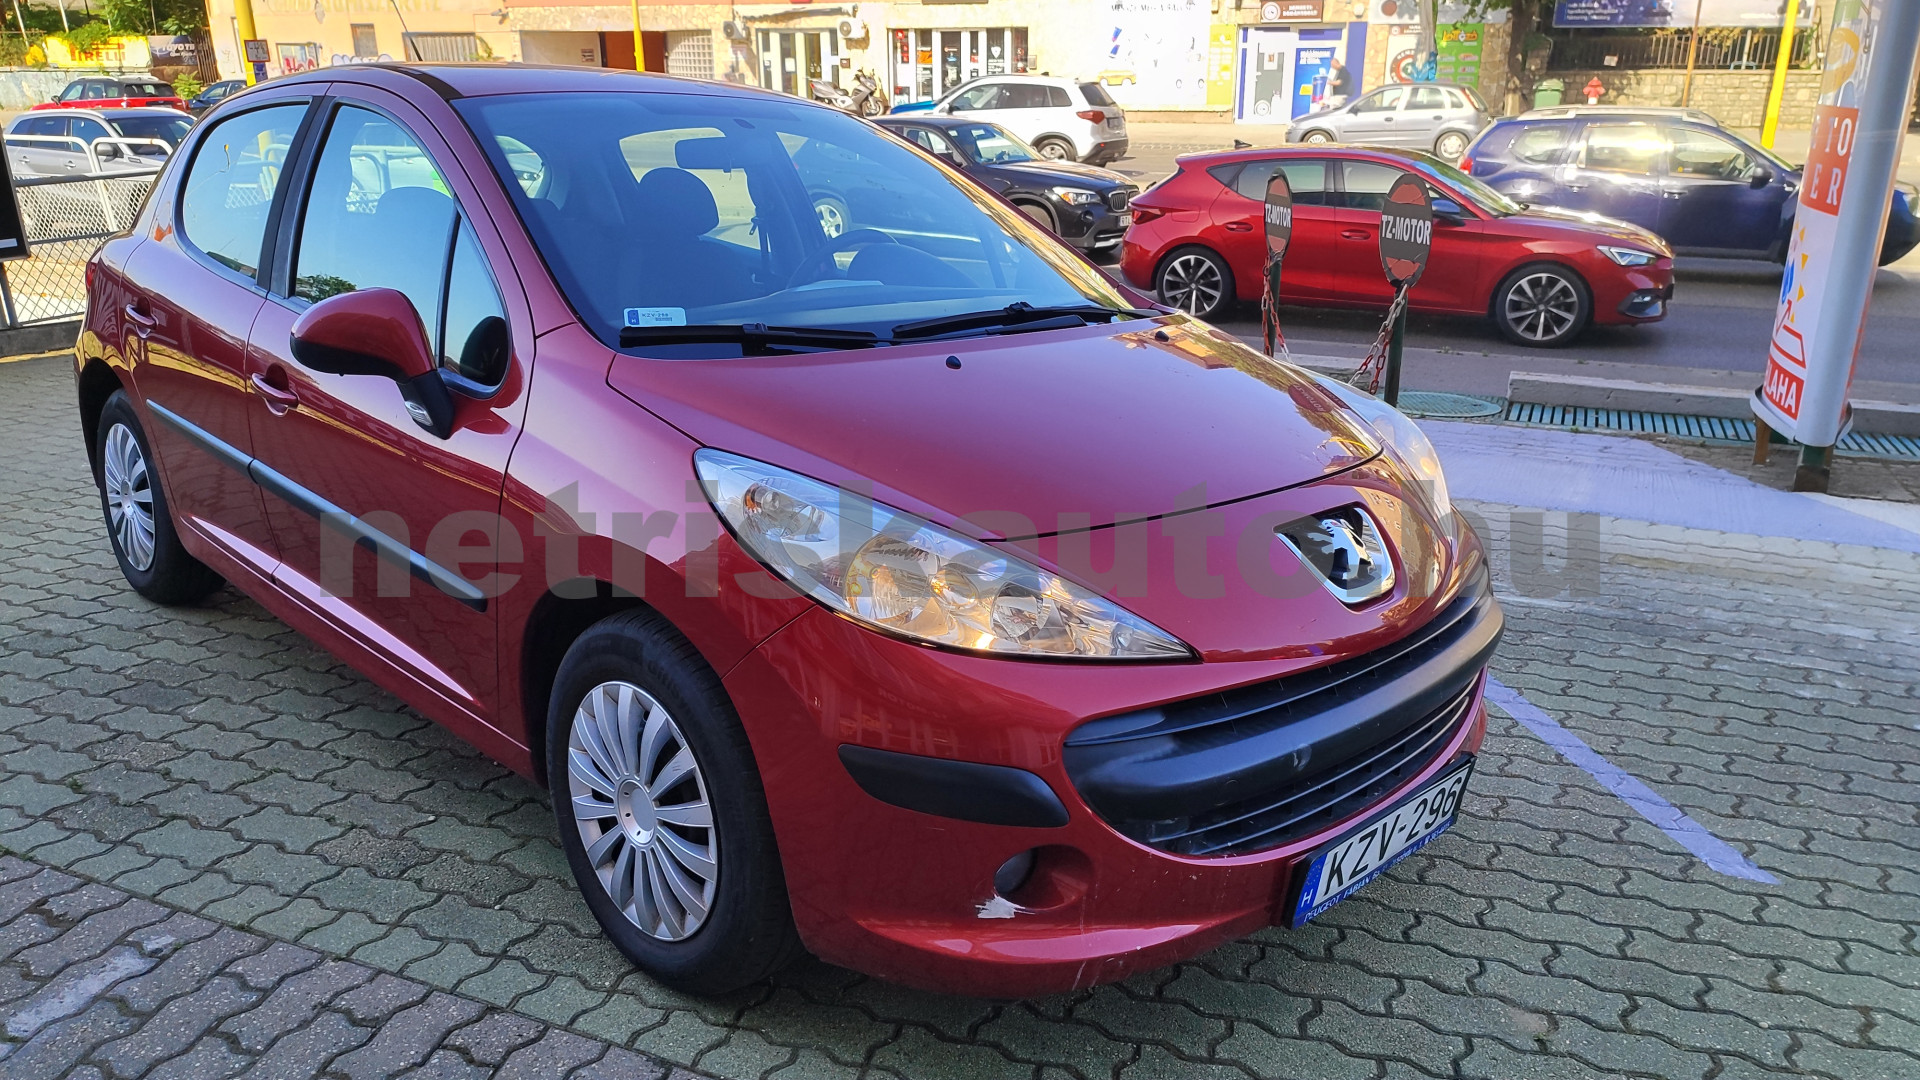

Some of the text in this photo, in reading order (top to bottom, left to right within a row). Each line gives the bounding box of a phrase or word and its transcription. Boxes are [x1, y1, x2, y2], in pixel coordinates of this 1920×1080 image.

[1265, 203, 1292, 228] TZ-MOTOR
[1381, 214, 1432, 246] TZ-MOTOR
[1323, 776, 1462, 897] KZV-296
[1300, 889, 1313, 908] H
